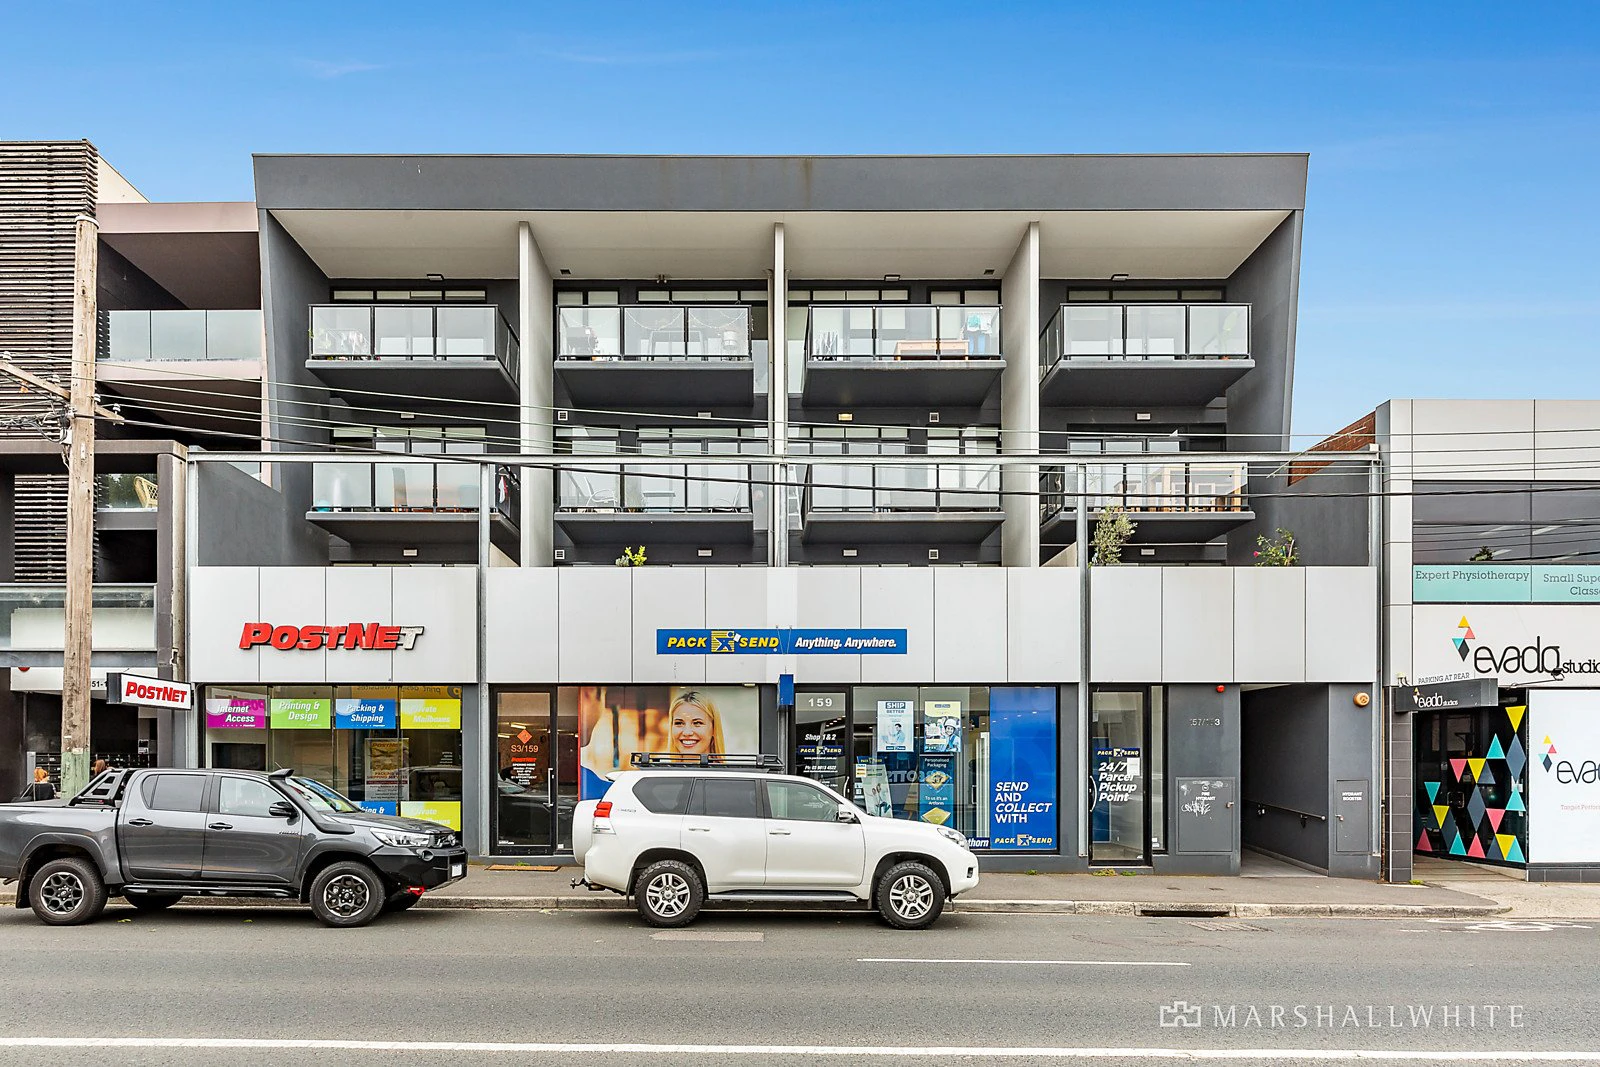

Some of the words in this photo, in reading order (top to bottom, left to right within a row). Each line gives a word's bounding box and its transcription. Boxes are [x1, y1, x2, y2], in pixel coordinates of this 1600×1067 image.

[1415, 571, 1450, 581] Expert
[1452, 570, 1530, 582] Physiotherapy
[1543, 573, 1575, 583] Small
[1569, 586, 1600, 596] Class
[667, 636, 708, 648] PACK
[738, 636, 780, 648] SEND
[794, 636, 843, 650] Anything.
[843, 636, 898, 649] Anywhere.
[1418, 675, 1443, 684] PARKING
[1453, 672, 1470, 680] REAR
[279, 701, 311, 711] Printing
[313, 701, 320, 710] &
[808, 697, 833, 707] 159
[346, 704, 377, 714] Packing
[378, 704, 385, 712] &
[225, 713, 255, 723] Access
[288, 711, 319, 722] Design
[350, 714, 384, 723] Shipping
[805, 733, 821, 742] Shop
[1098, 761, 1128, 773] 24/7
[1556, 760, 1600, 785] eva
[995, 781, 1029, 792] SEND
[1098, 782, 1138, 793] Pickup
[994, 792, 1022, 802] AND
[1098, 792, 1130, 802] Point
[995, 802, 1053, 813] COLLECT
[994, 813, 1028, 824] WITH
[967, 838, 990, 847] thorn
